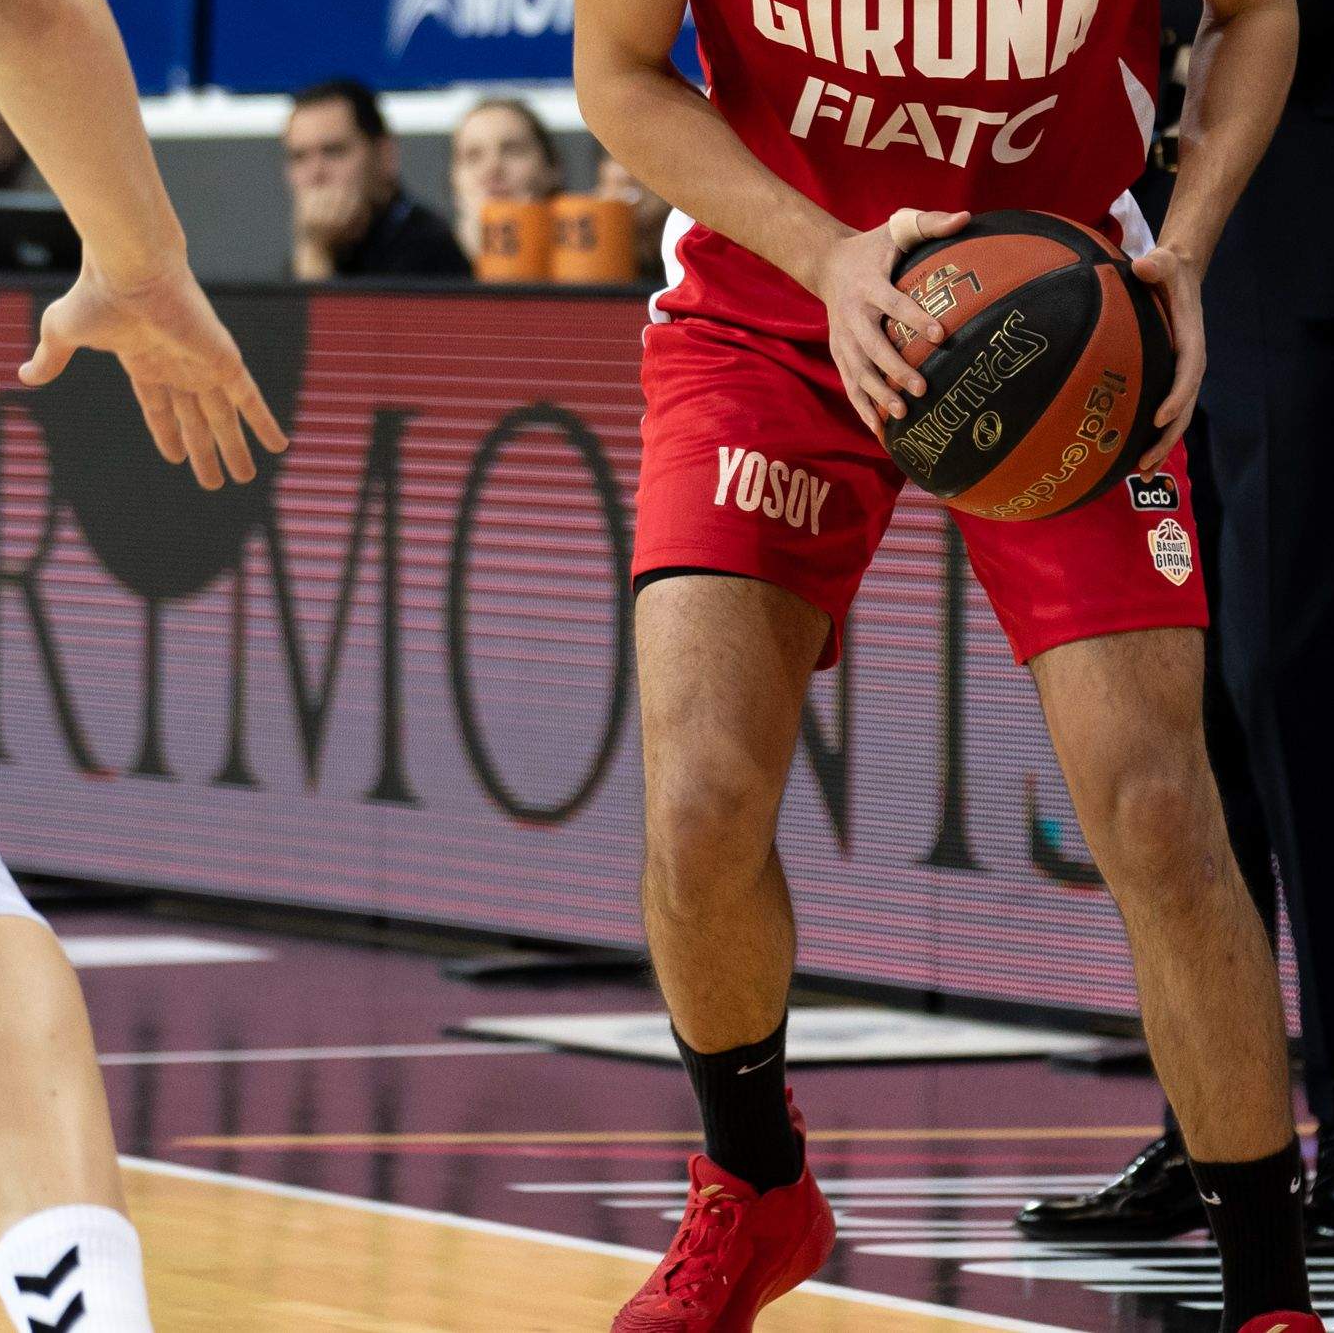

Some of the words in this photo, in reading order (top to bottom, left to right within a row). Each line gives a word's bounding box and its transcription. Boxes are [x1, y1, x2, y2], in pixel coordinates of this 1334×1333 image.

[789, 76, 1059, 168] FIATC
[892, 309, 1049, 479] SPALDING
[1076, 368, 1128, 442] liga
[713, 446, 832, 537] YOSOY
[1138, 488, 1171, 505] acb
[1155, 553, 1192, 570] GIRONA
